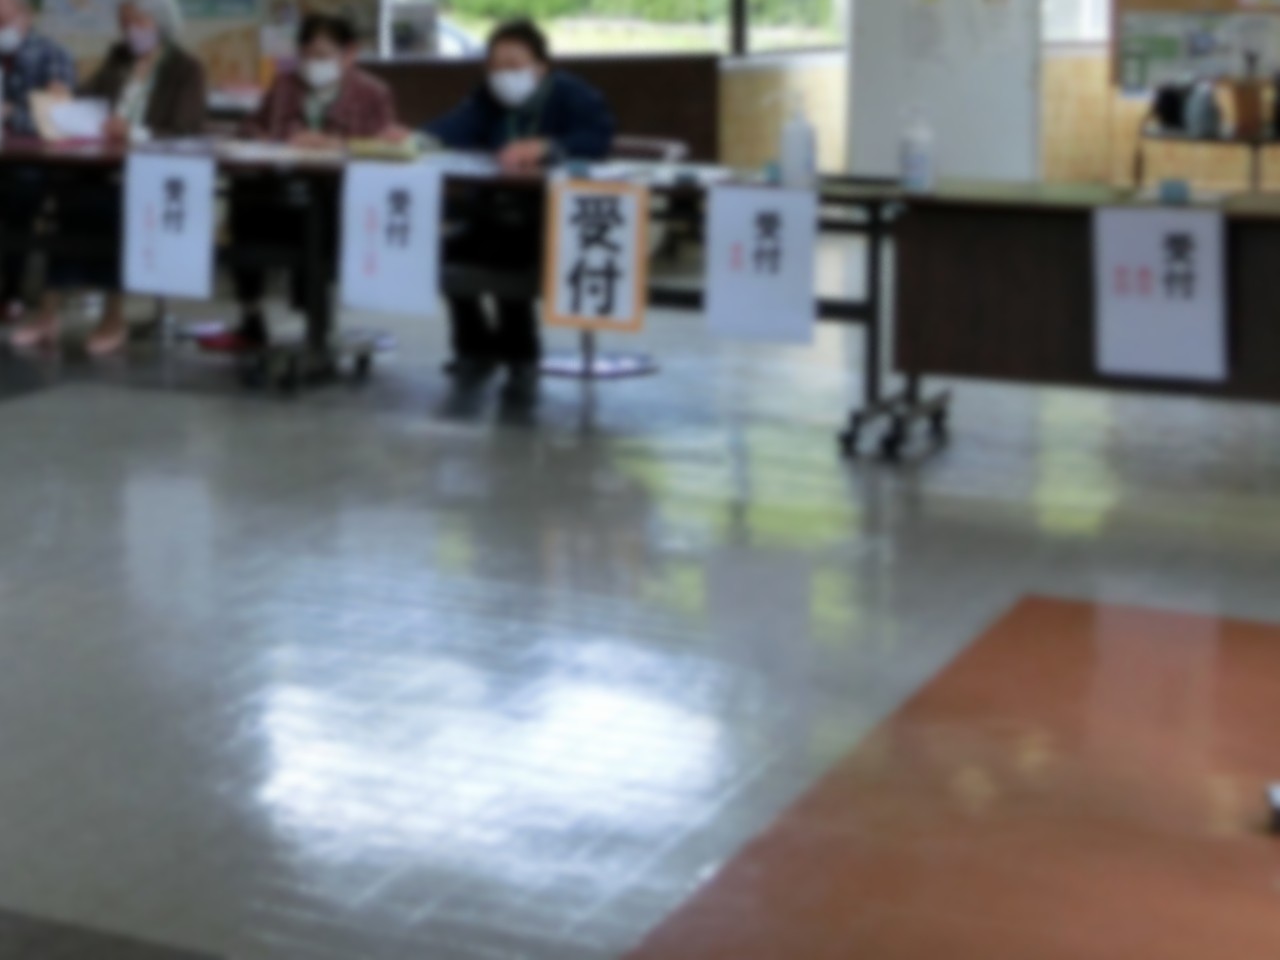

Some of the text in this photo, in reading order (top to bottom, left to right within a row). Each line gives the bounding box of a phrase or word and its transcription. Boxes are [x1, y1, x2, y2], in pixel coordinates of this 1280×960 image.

[163, 177, 186, 234] 受付
[385, 188, 412, 249] 受付
[567, 194, 625, 316] 受付
[754, 212, 782, 273] 受付
[1163, 231, 1197, 299] 受付
